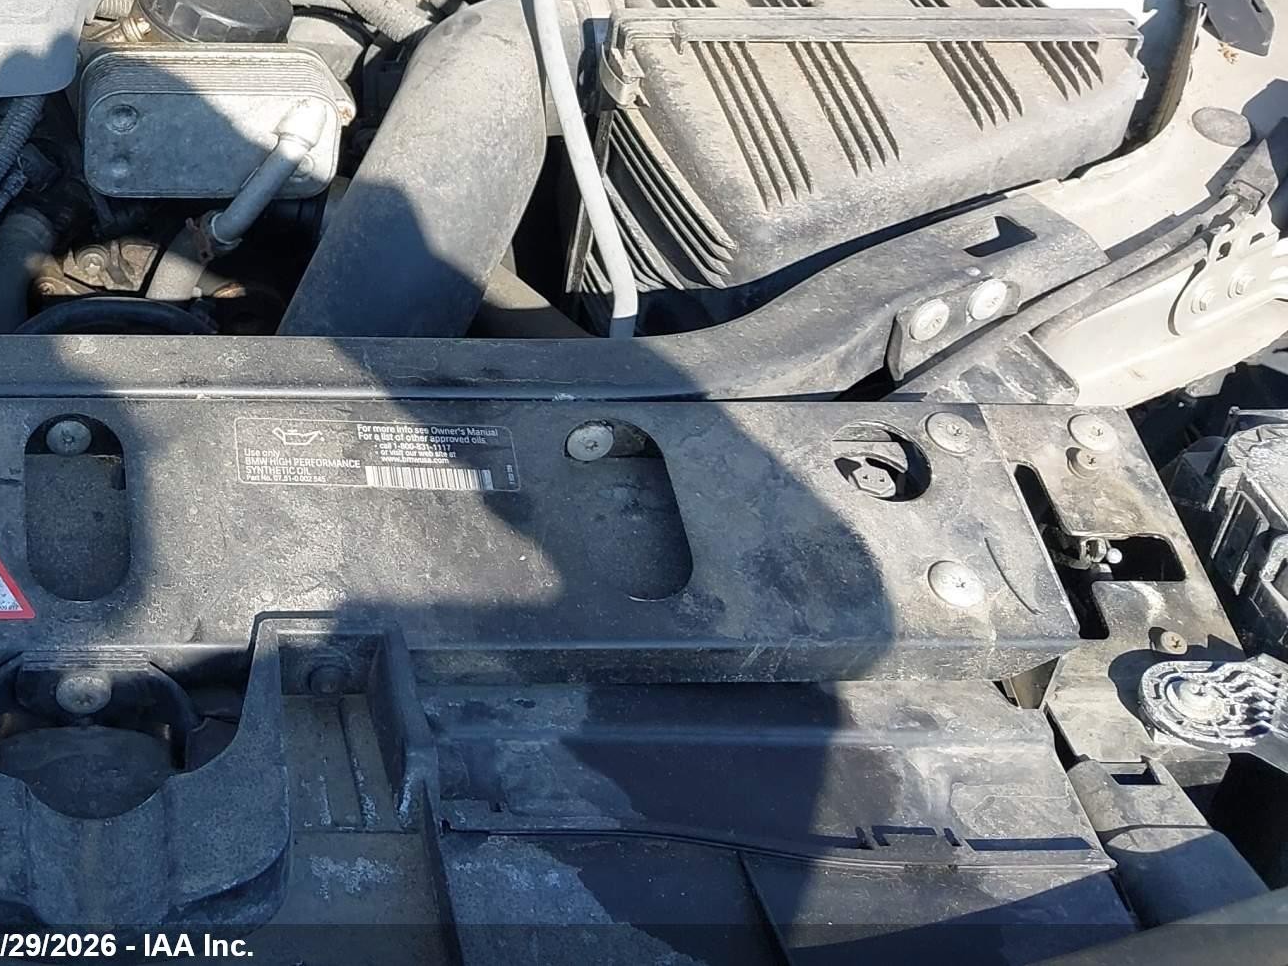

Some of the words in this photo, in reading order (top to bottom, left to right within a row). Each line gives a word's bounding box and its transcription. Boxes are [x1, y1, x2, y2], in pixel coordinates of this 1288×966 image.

[357, 424, 372, 433] For
[373, 425, 396, 433] more
[414, 426, 429, 434] see
[430, 426, 466, 435] Owner's
[466, 427, 499, 437] Manual
[358, 432, 372, 440] For
[381, 432, 394, 441] list
[395, 433, 404, 441] of
[405, 433, 428, 442] other
[429, 433, 470, 444] approved
[244, 448, 261, 457] Use
[262, 449, 281, 459] only
[245, 457, 268, 466] BMW
[269, 457, 292, 467] HIGH
[293, 458, 361, 468] PERFORMANCE
[245, 465, 296, 475] SYNTHETIC
[298, 466, 312, 476] OIL
